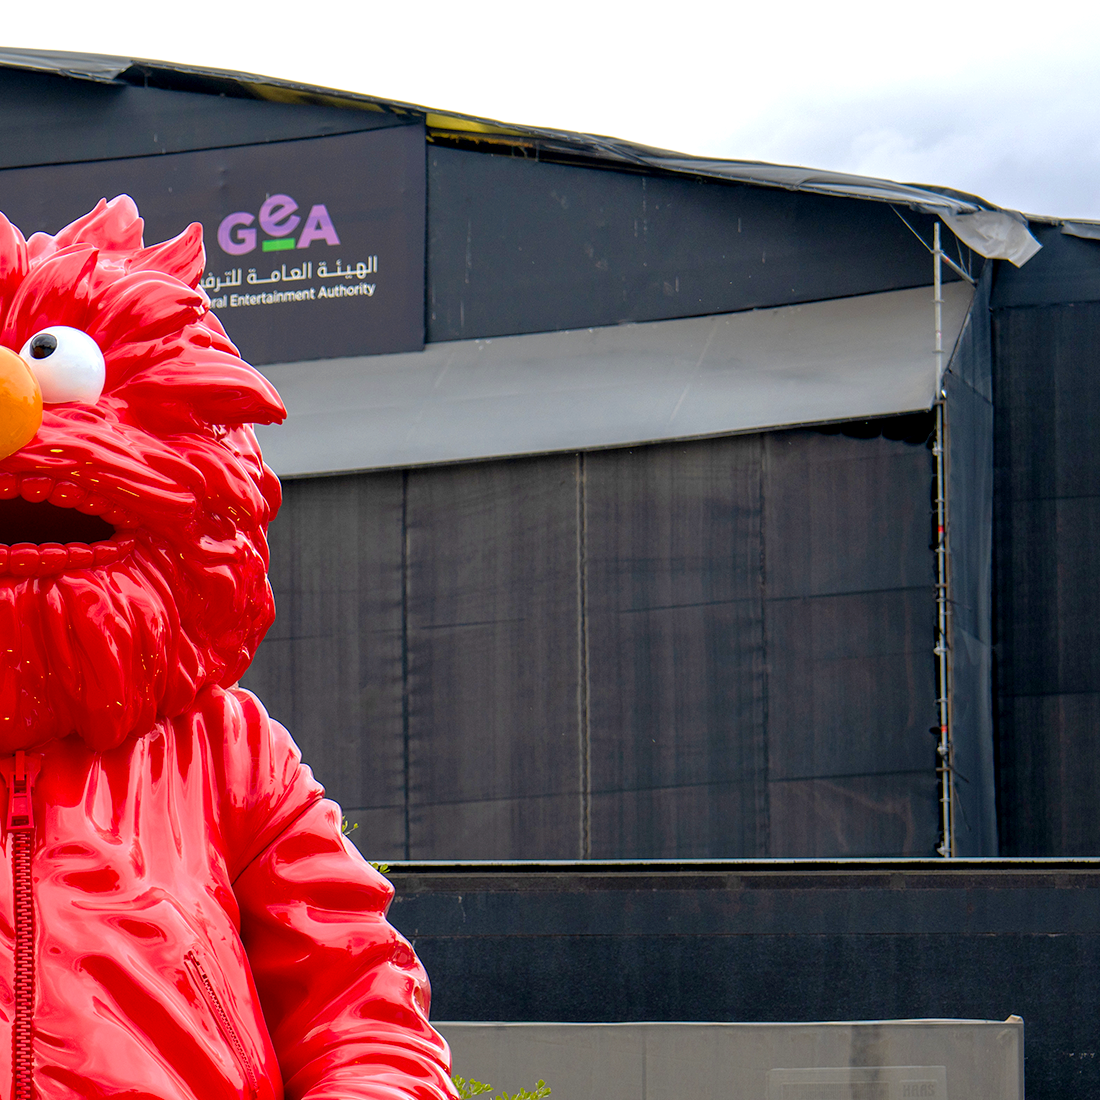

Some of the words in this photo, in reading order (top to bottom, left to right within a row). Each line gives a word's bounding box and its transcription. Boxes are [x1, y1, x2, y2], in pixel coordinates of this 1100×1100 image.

[246, 261, 313, 285] العامة
[316, 255, 378, 280] الهيئة
[229, 286, 316, 308] Entertainment
[317, 281, 377, 301] Authority
